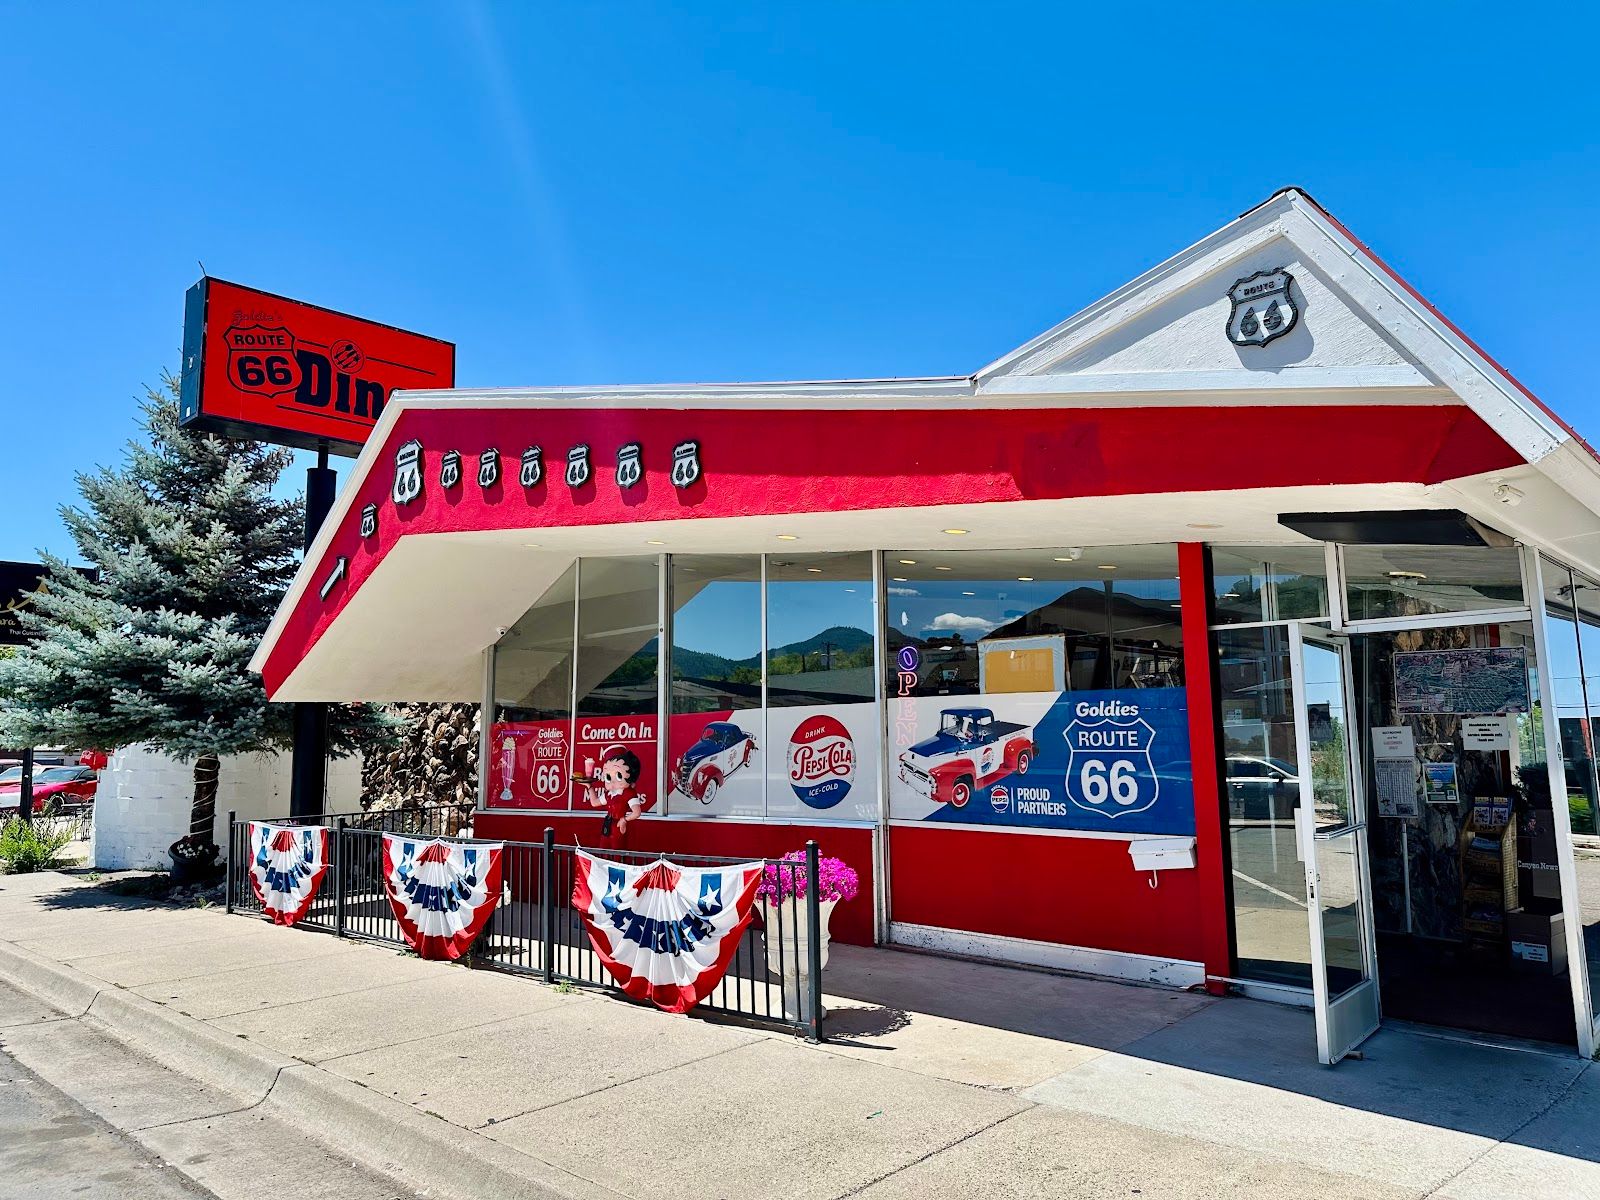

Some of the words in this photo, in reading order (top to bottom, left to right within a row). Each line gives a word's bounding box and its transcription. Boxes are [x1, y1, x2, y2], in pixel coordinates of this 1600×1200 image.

[1243, 280, 1275, 296] ROUTE
[1239, 300, 1281, 336] 66
[234, 334, 285, 346] ROUTE
[238, 355, 292, 386] 66
[295, 349, 402, 420] Din
[443, 467, 455, 483] 66
[481, 464, 495, 483] 66
[523, 463, 538, 482] 66
[570, 462, 585, 482] 66
[620, 461, 637, 482] 66
[676, 459, 694, 482] 66
[398, 468, 416, 495] 66
[362, 518, 373, 534] 66
[896, 646, 919, 746] OPEN
[1076, 700, 1139, 717] Goldies
[538, 728, 564, 738] Goldies
[581, 723, 616, 740] Come
[618, 722, 637, 739] On
[639, 722, 652, 738] In
[804, 726, 826, 739] DRINK
[1078, 730, 1139, 747] ROUTE
[538, 746, 562, 757] ROUTE
[537, 764, 560, 794] 66
[1080, 759, 1139, 806] 66
[808, 783, 839, 797] ICE-COLD
[1016, 787, 1051, 801] PROUD
[1017, 801, 1067, 816] PARTNERS
